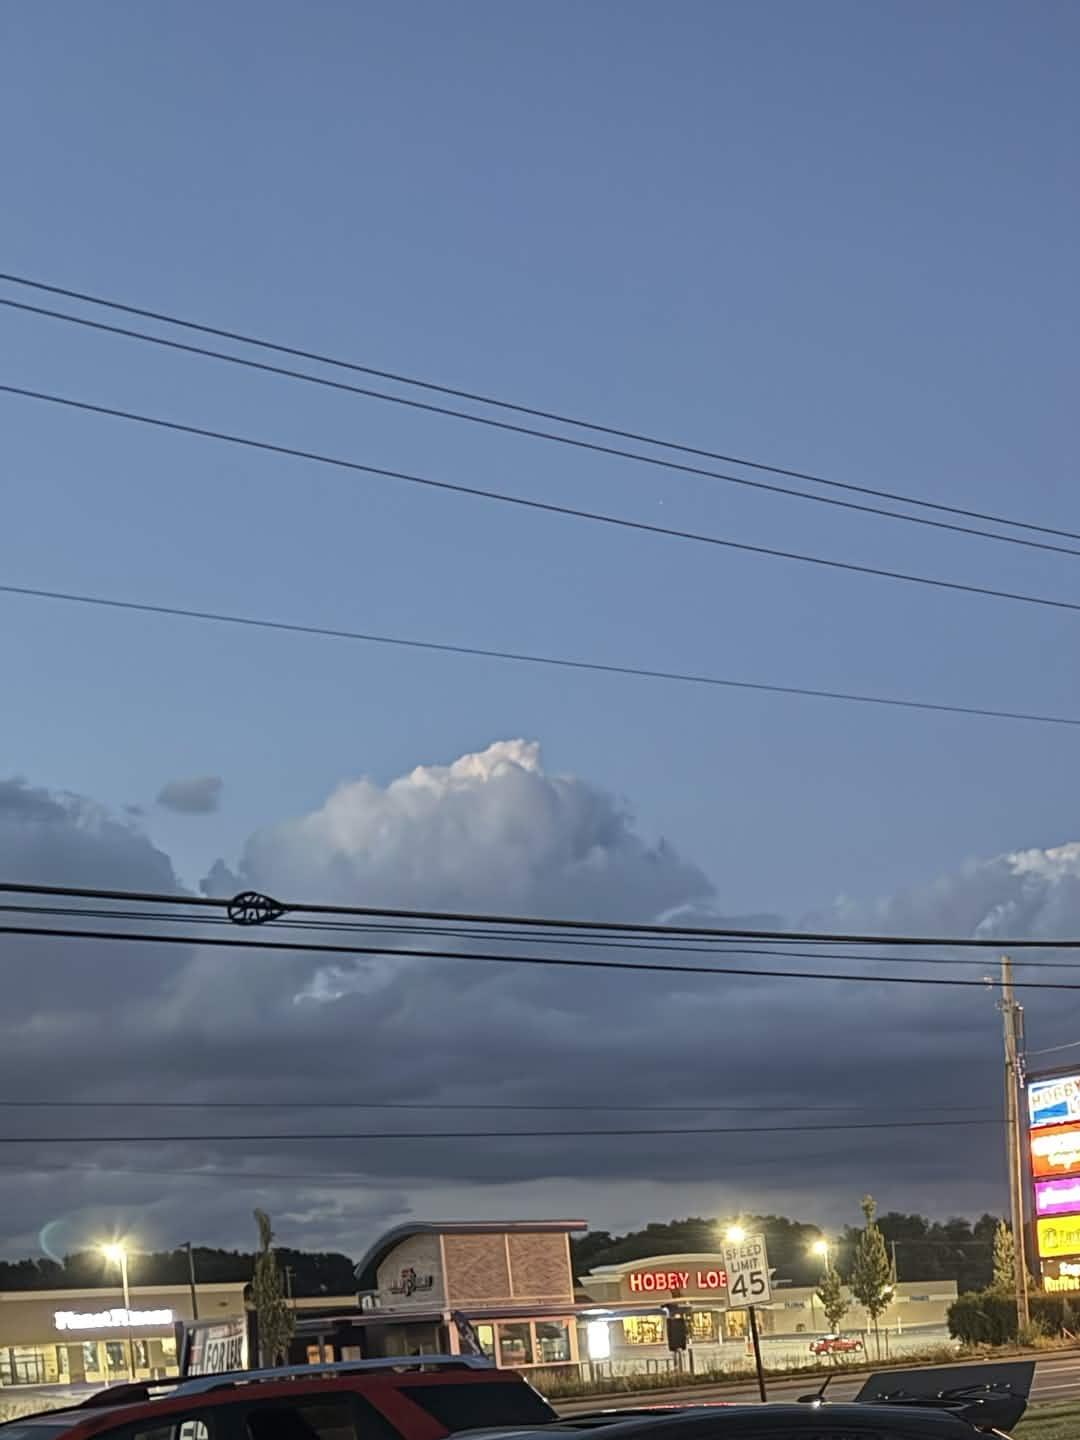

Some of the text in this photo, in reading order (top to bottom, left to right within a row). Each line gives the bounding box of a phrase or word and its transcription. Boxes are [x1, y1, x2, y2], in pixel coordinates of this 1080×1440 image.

[725, 1244, 761, 1261] SPEED
[731, 1257, 758, 1273] LIMIT
[630, 1271, 727, 1292] HOBBY LOB
[731, 1271, 765, 1297] 45
[206, 1343, 224, 1371] FOR
